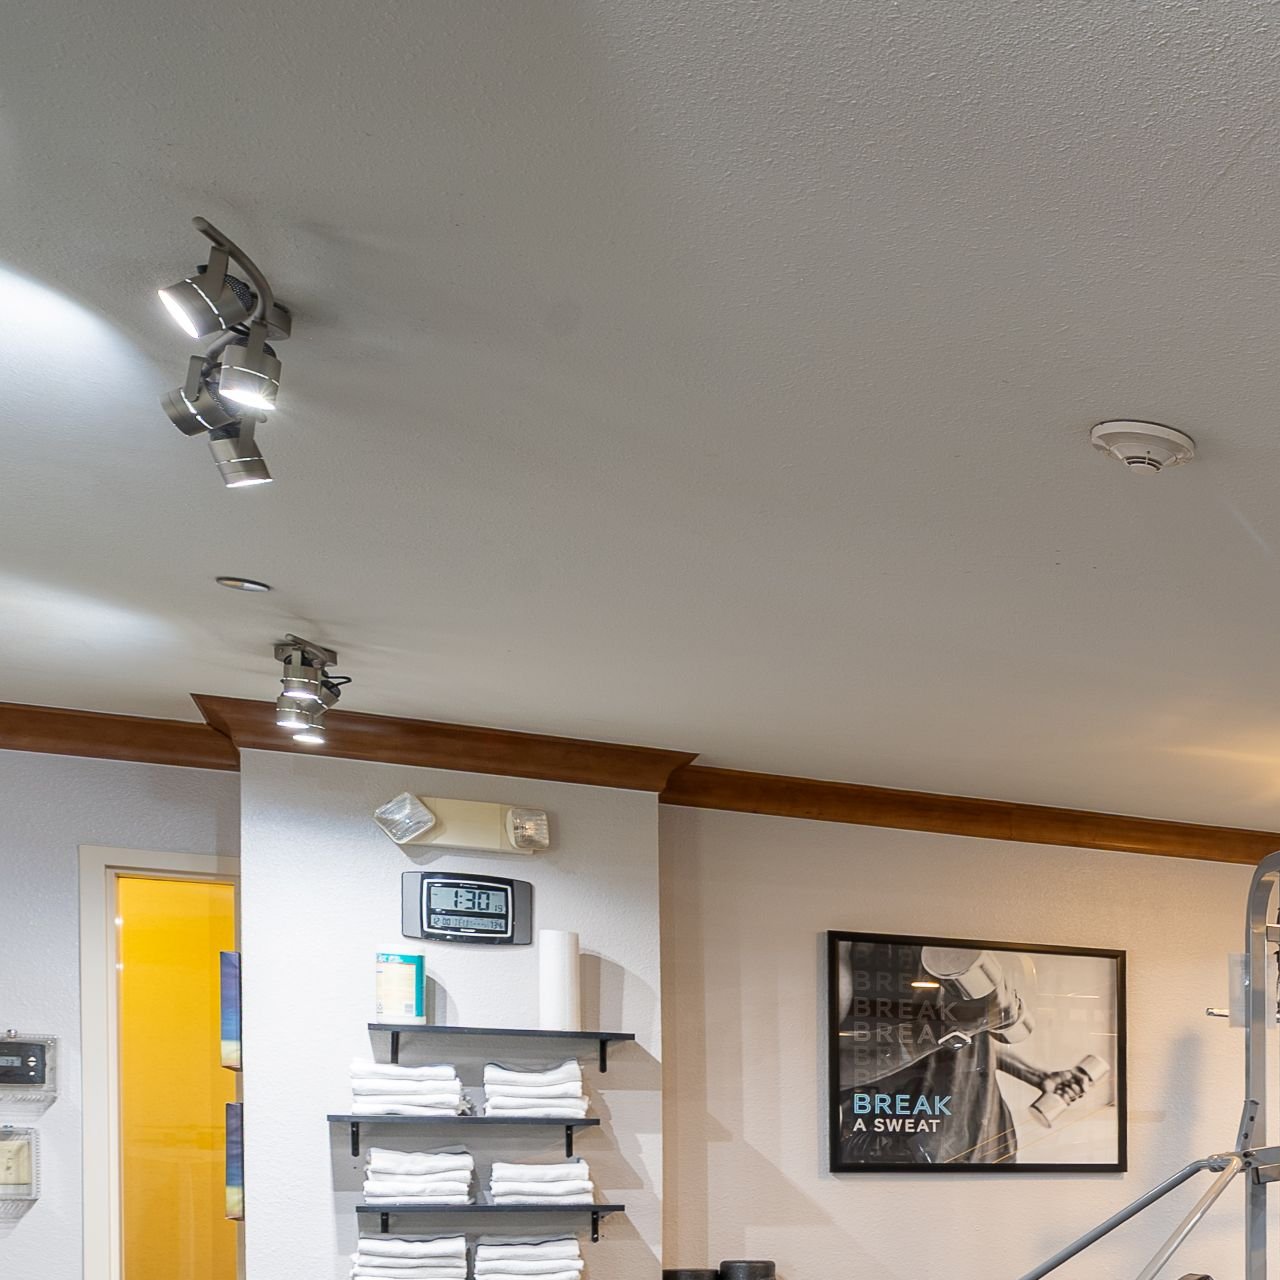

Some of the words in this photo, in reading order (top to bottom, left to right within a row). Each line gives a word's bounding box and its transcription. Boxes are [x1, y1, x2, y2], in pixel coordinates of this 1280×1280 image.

[454, 889, 490, 911] 1:30
[854, 996, 959, 1022] BREAK
[853, 1093, 952, 1116] BREAK
[853, 1118, 867, 1132] A
[873, 1118, 941, 1133] SWEAT
